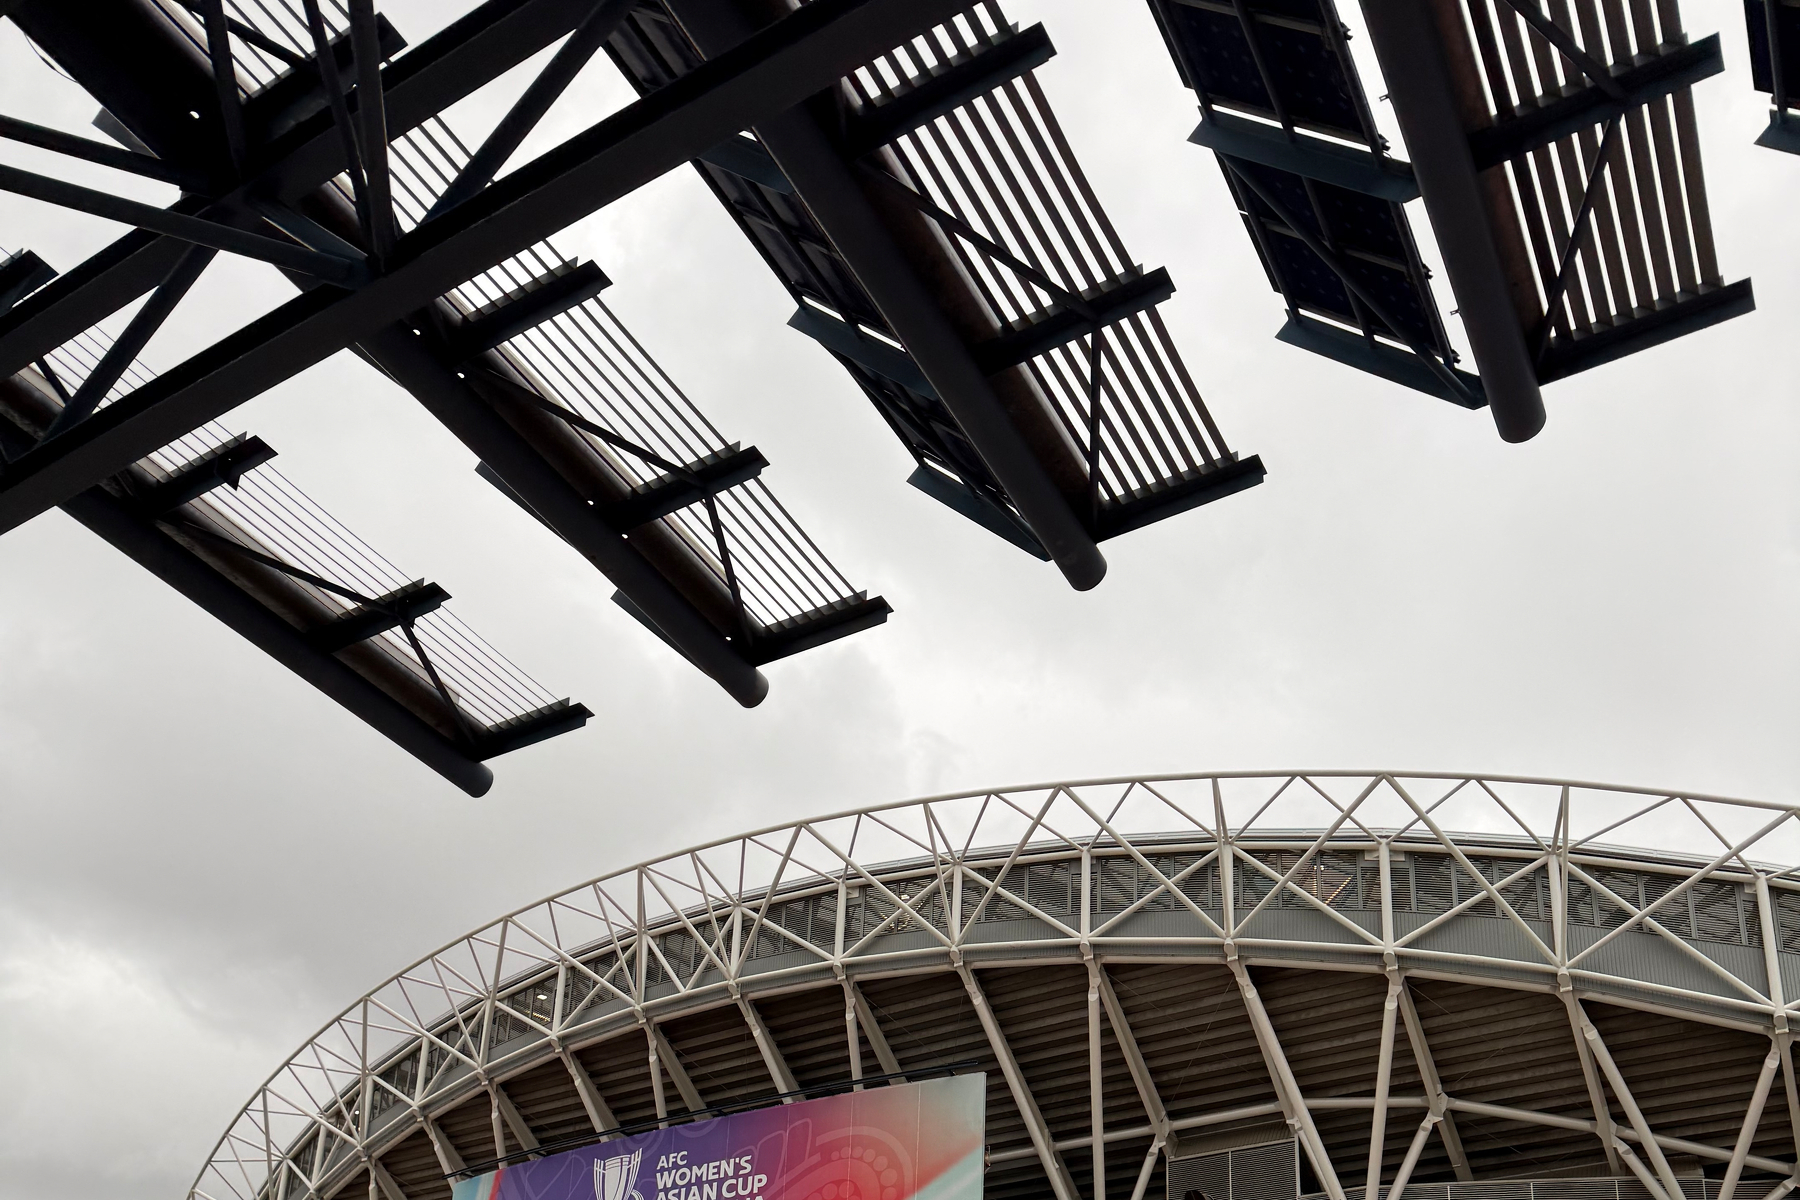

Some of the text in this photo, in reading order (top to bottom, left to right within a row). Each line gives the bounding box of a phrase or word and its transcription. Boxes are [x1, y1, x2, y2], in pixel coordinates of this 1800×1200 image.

[656, 1151, 688, 1170] AFC
[656, 1155, 752, 1190] WOMEN'S
[721, 1174, 768, 1198] CUP
